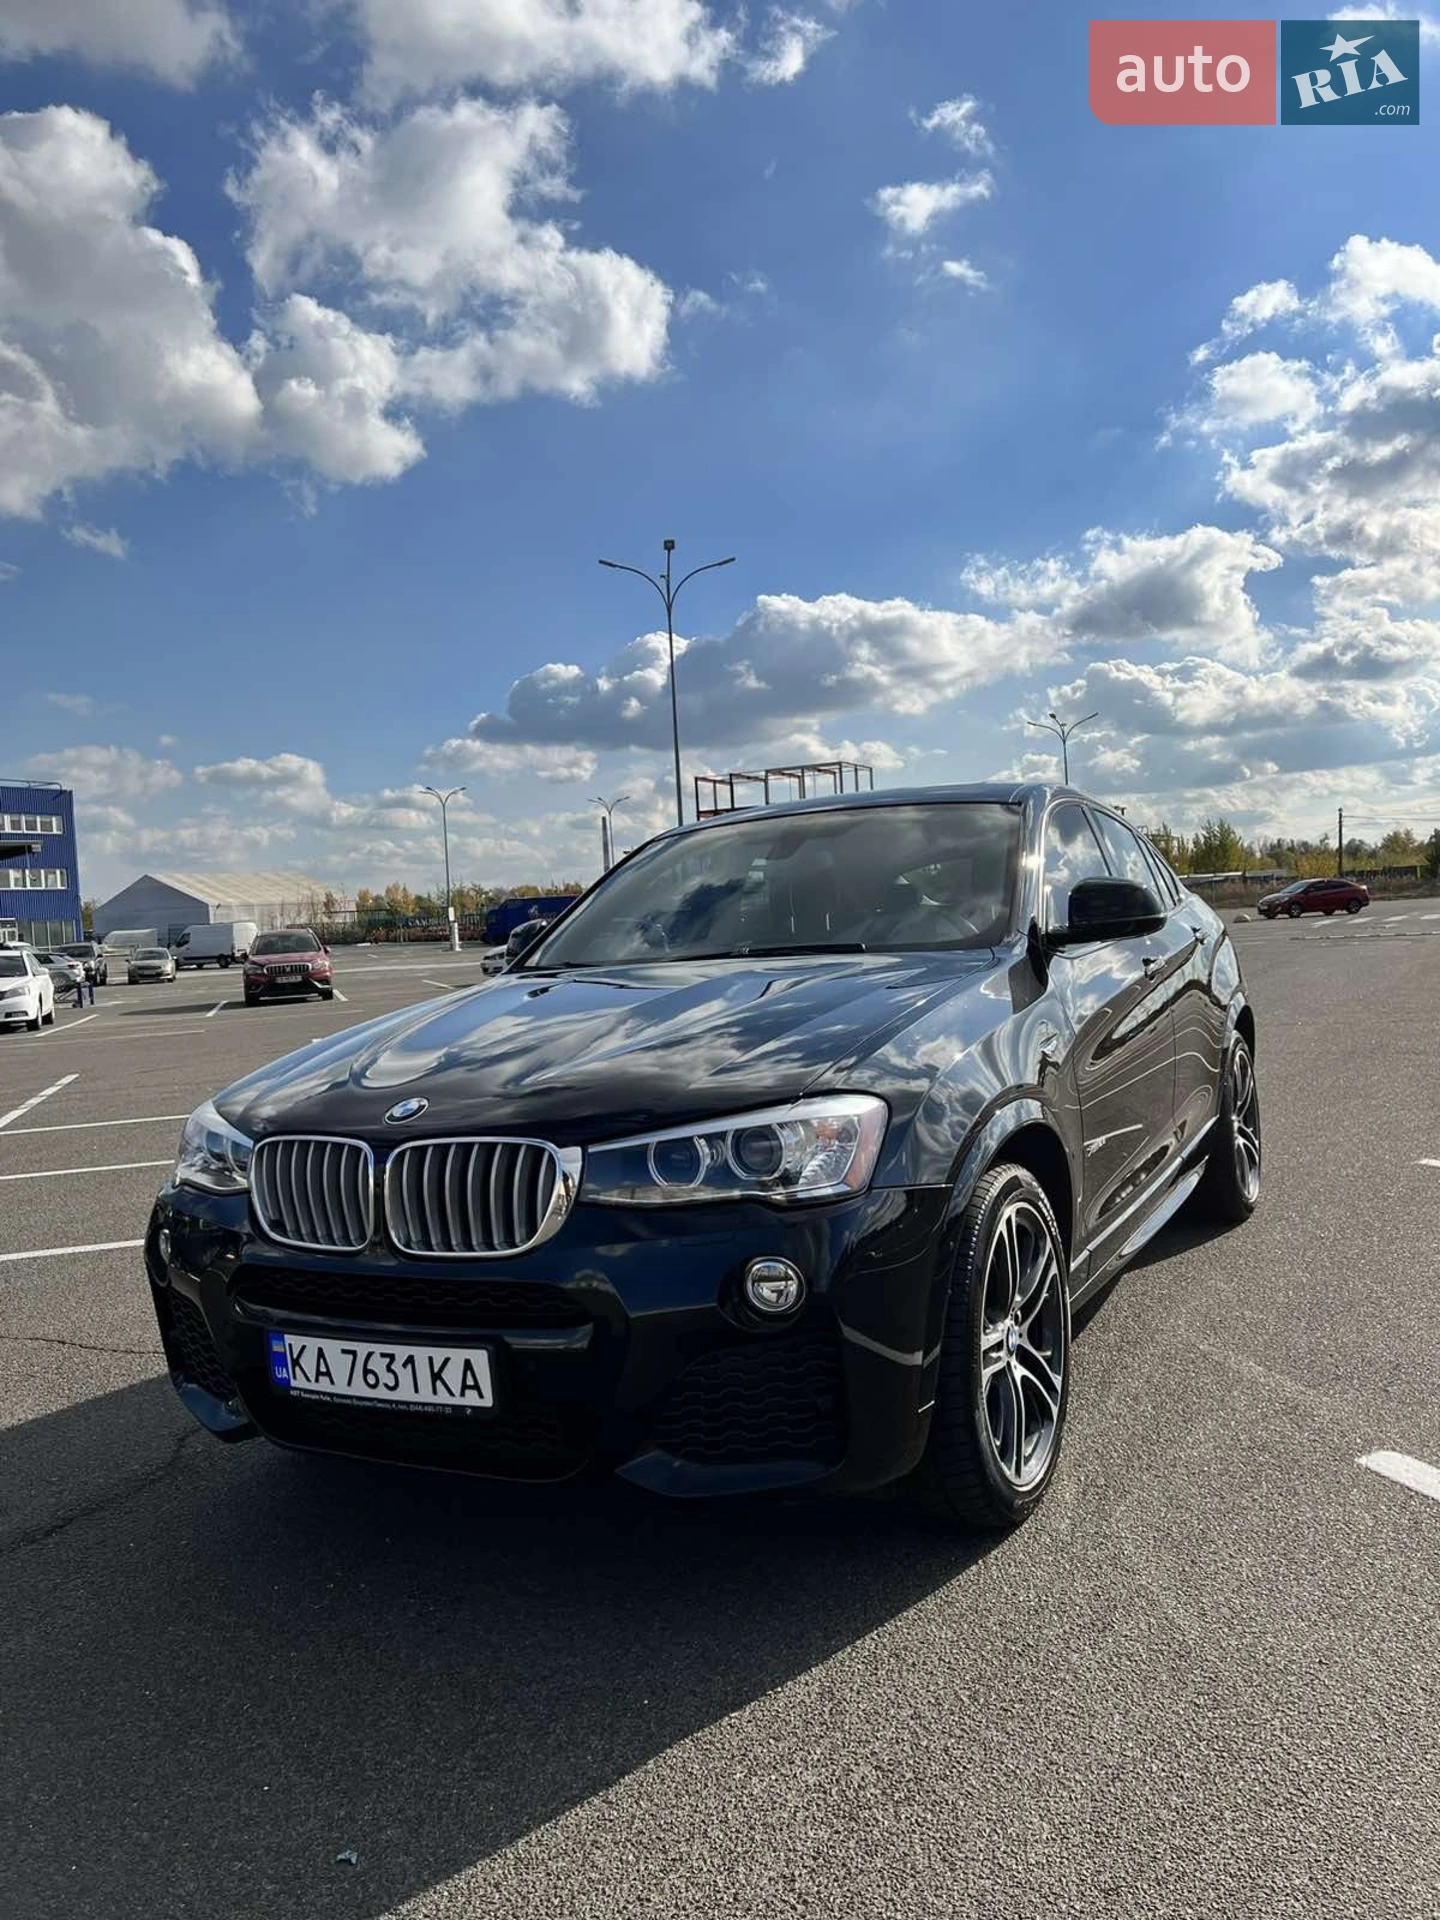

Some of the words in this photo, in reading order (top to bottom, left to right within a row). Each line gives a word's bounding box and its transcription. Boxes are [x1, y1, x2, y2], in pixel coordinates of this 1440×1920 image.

[275, 1366, 289, 1380] UA
[288, 1342, 335, 1386] KA
[341, 1348, 419, 1394] 7631
[428, 1356, 484, 1400] KA
